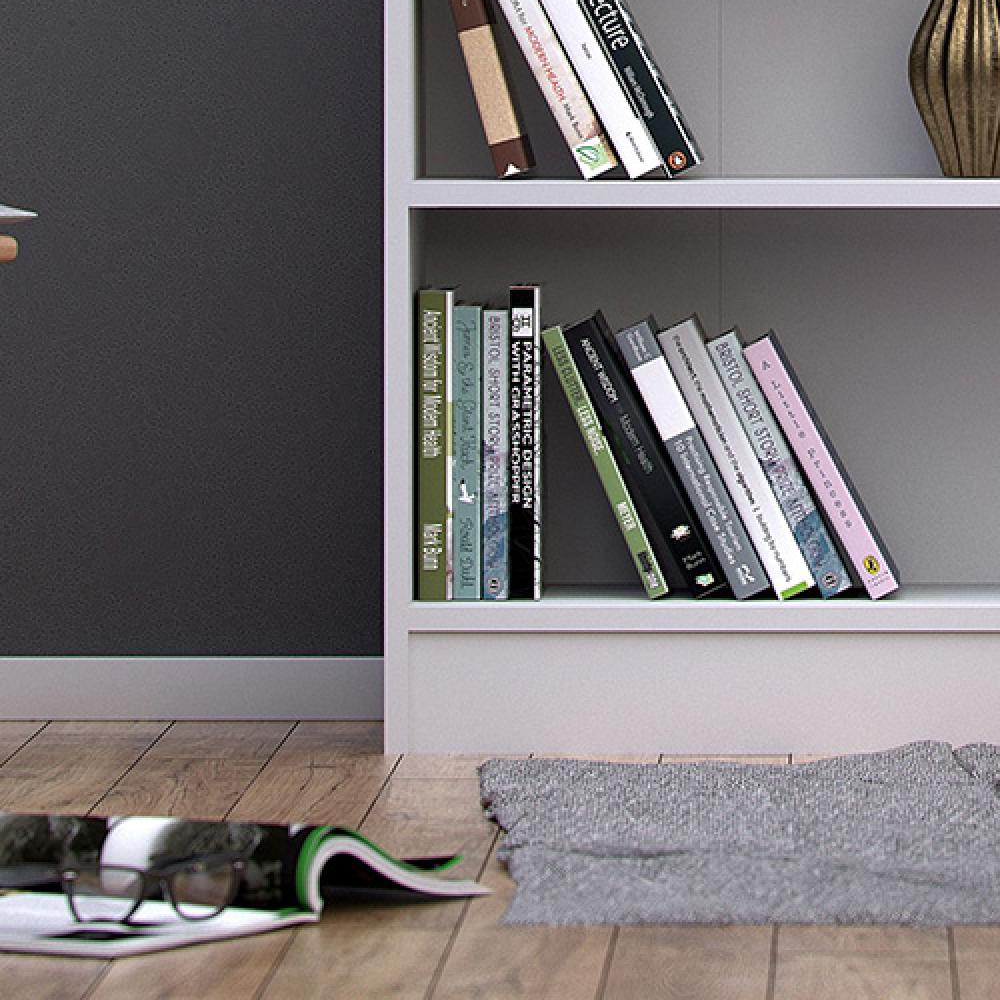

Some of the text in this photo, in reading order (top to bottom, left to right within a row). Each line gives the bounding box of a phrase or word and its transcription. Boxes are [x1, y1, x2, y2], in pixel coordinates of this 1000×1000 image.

[524, 25, 550, 68] MODERN
[545, 67, 566, 102] HEALTH
[488, 315, 500, 363] BRISTOL
[760, 359, 770, 370] A
[422, 308, 442, 457] Ancient Wisdom for Modern Health
[488, 367, 500, 407] SHORT
[521, 340, 532, 444] PARAMETRIC
[579, 336, 618, 403] ANCIENT WISDOM
[488, 412, 500, 450] STORY
[510, 340, 520, 503] WITH GRASSHOPPER
[577, 405, 593, 427] LESS
[715, 341, 745, 388] BRISTOL
[736, 387, 763, 427] SHORT
[753, 425, 782, 468] STORY
[521, 448, 532, 508] DESIGN
[422, 523, 442, 546] Mark
